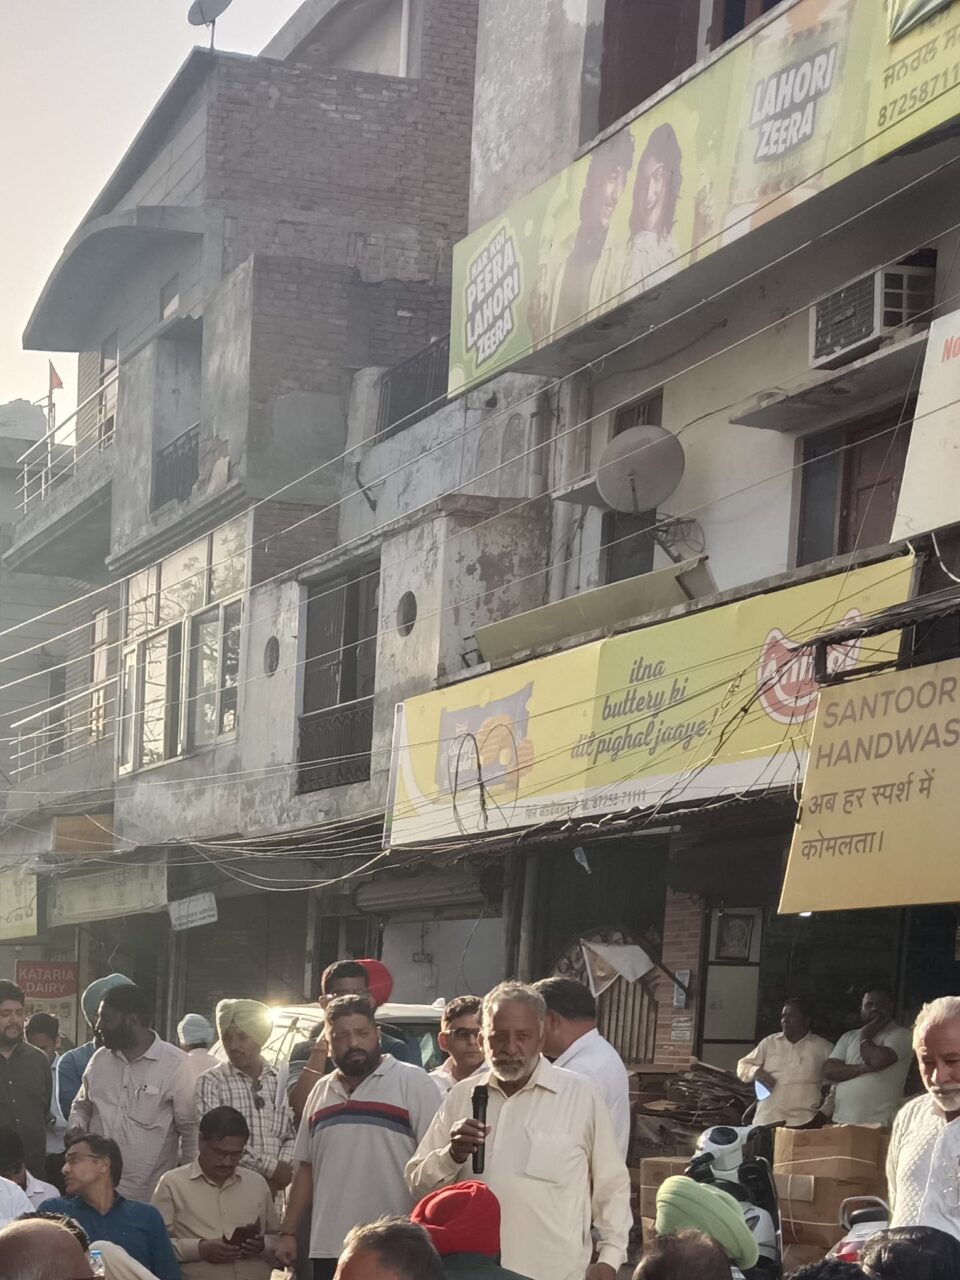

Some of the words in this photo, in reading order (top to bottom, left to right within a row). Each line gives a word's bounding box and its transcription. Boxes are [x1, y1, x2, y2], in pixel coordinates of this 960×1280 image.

[751, 46, 836, 125] LAHORI
[756, 101, 815, 159] ZEERA
[467, 240, 515, 314] PEERA
[471, 250, 488, 280] HAR
[490, 229, 505, 258] KOI
[467, 266, 519, 349] LAHORI
[477, 307, 512, 364] ZEERA
[629, 656, 665, 684] itna
[602, 688, 665, 720] buttery
[670, 677, 689, 705] ki
[823, 676, 957, 728] SANTOOR
[571, 731, 596, 760] dil
[593, 719, 655, 765] pighal
[816, 718, 960, 769] HANDWAS
[808, 791, 838, 814] अब
[843, 787, 866, 814] हर
[872, 771, 915, 805] स्पर्श
[918, 768, 935, 799] में
[18, 968, 74, 980] KATARIA
[26, 982, 66, 993] DAIRY
